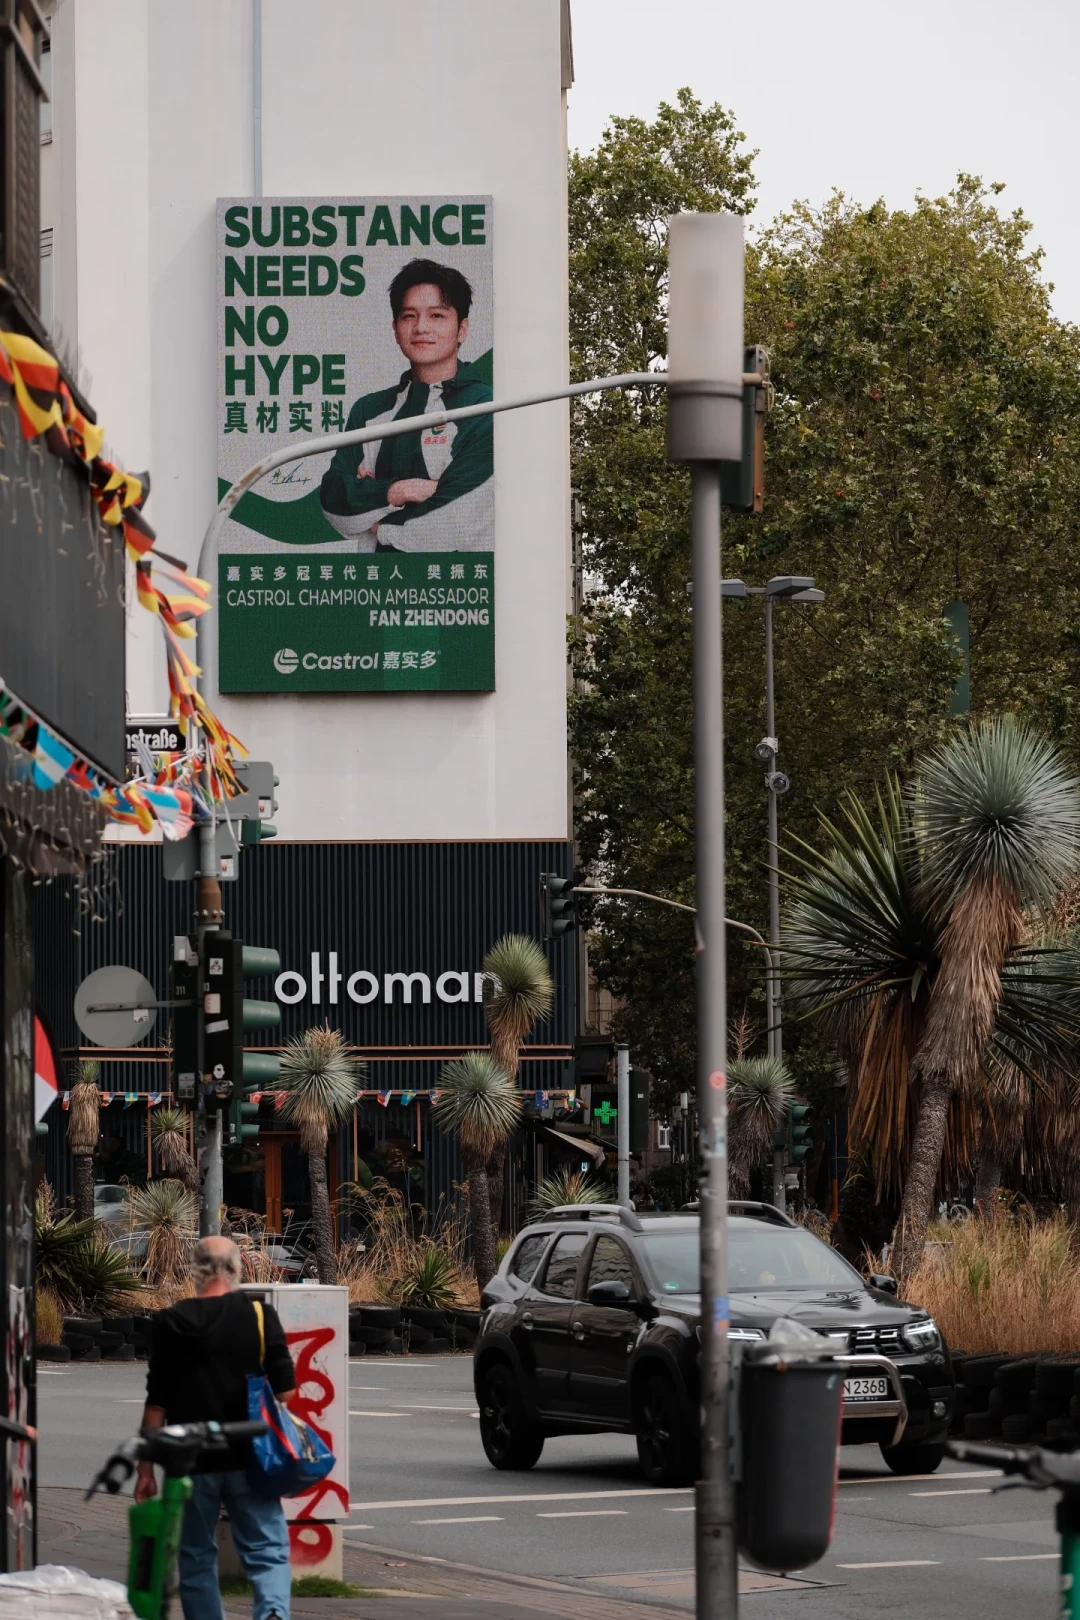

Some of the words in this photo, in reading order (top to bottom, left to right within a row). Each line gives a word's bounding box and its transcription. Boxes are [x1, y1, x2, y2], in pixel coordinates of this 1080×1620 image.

[224, 204, 486, 247] SUBSTANCE
[224, 254, 366, 297] NEEDS
[224, 305, 289, 347] NO
[224, 354, 346, 395] HYPE
[223, 400, 345, 434] 真材实料
[227, 564, 403, 582] 嘉实多冠军代言人
[427, 563, 489, 580] 樊振东
[226, 589, 295, 607] CASTROL
[298, 588, 381, 606] CHAMPION
[384, 587, 489, 605] AMBASSADOR
[369, 609, 401, 627] FAN
[404, 608, 490, 626] ZHENDONG
[302, 652, 379, 670] Castrol
[382, 650, 437, 669] 嘉实多
[274, 951, 504, 1004] ottoman
[854, 1380, 885, 1394] 2368
